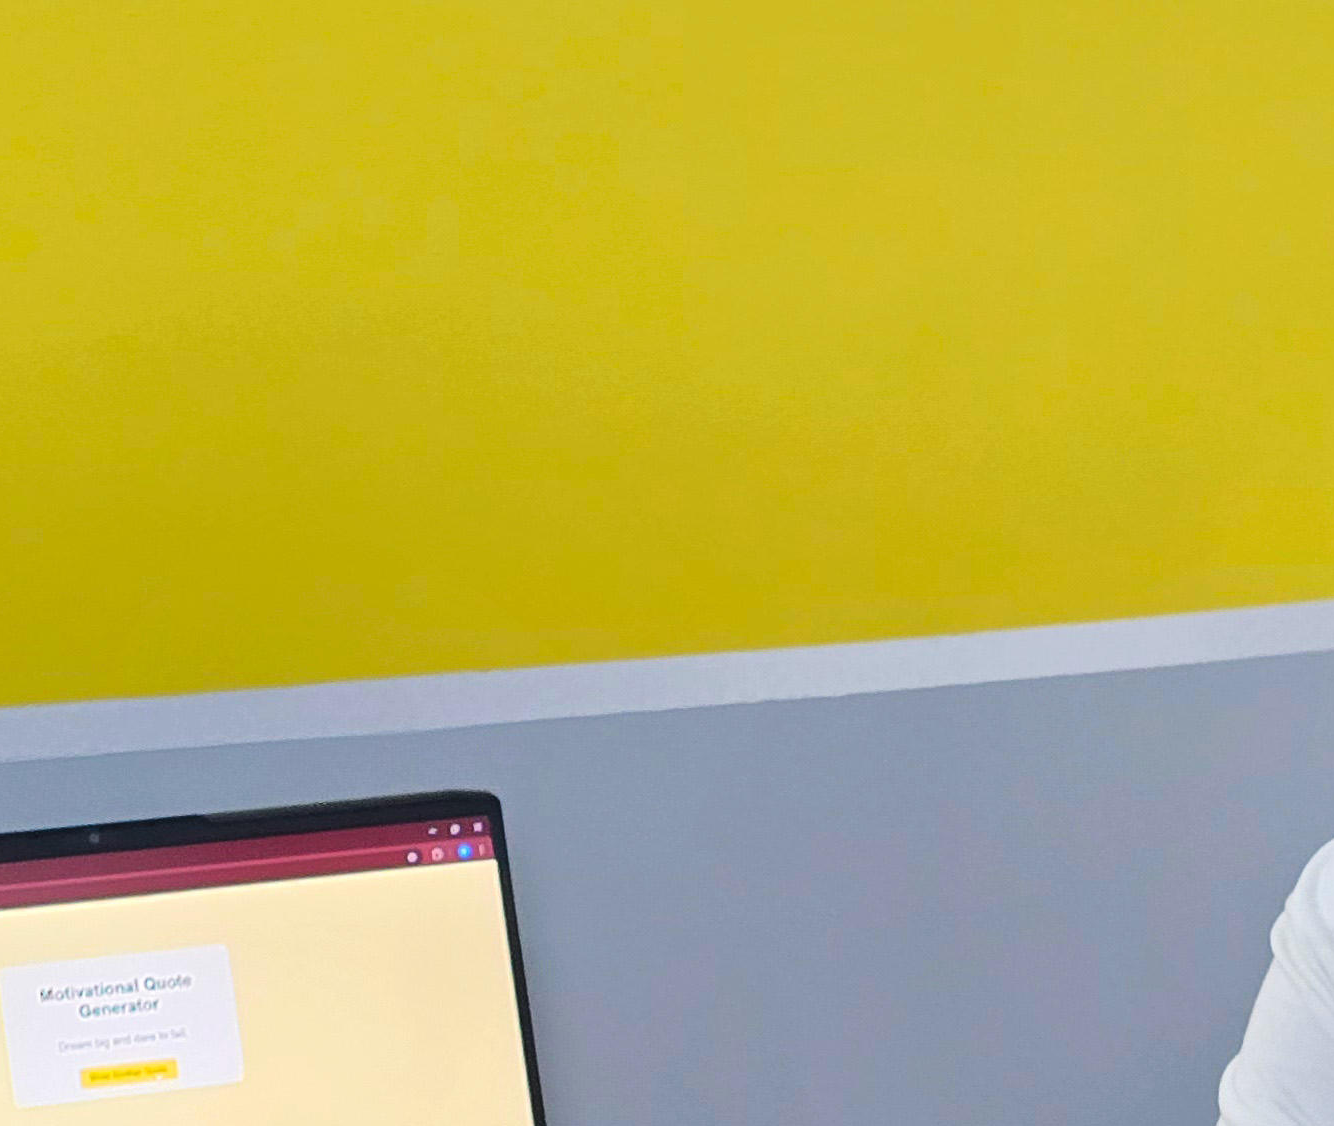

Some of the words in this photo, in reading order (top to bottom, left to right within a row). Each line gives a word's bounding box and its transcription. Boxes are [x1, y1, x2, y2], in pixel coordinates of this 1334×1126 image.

[40, 978, 139, 1002] Motivational
[143, 974, 192, 992] Quote
[78, 997, 160, 1018] Generator
